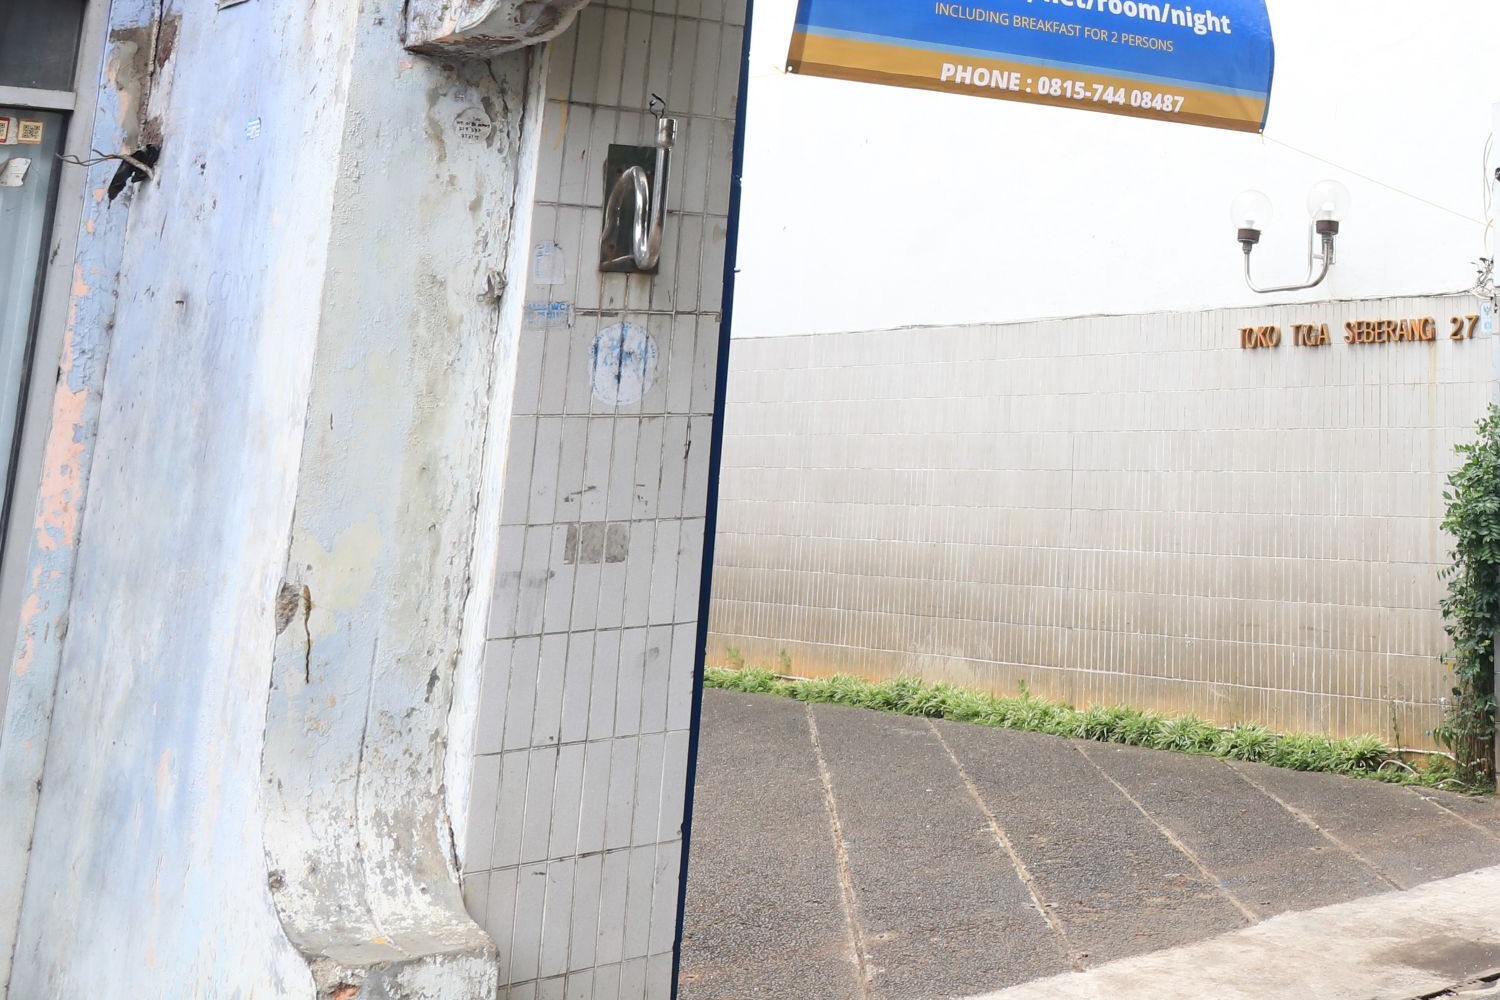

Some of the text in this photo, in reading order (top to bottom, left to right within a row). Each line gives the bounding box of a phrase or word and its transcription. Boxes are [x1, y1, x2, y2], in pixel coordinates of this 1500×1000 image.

[935, 2, 1174, 53] INCLUDING BREAKFAST FOR 2 PERSONS
[940, 62, 1021, 92] PHONE
[1038, 75, 1126, 107] 0815-744
[1130, 89, 1185, 113] 08487
[1238, 314, 1480, 350] TOKO TIGA SEBERANG 27
